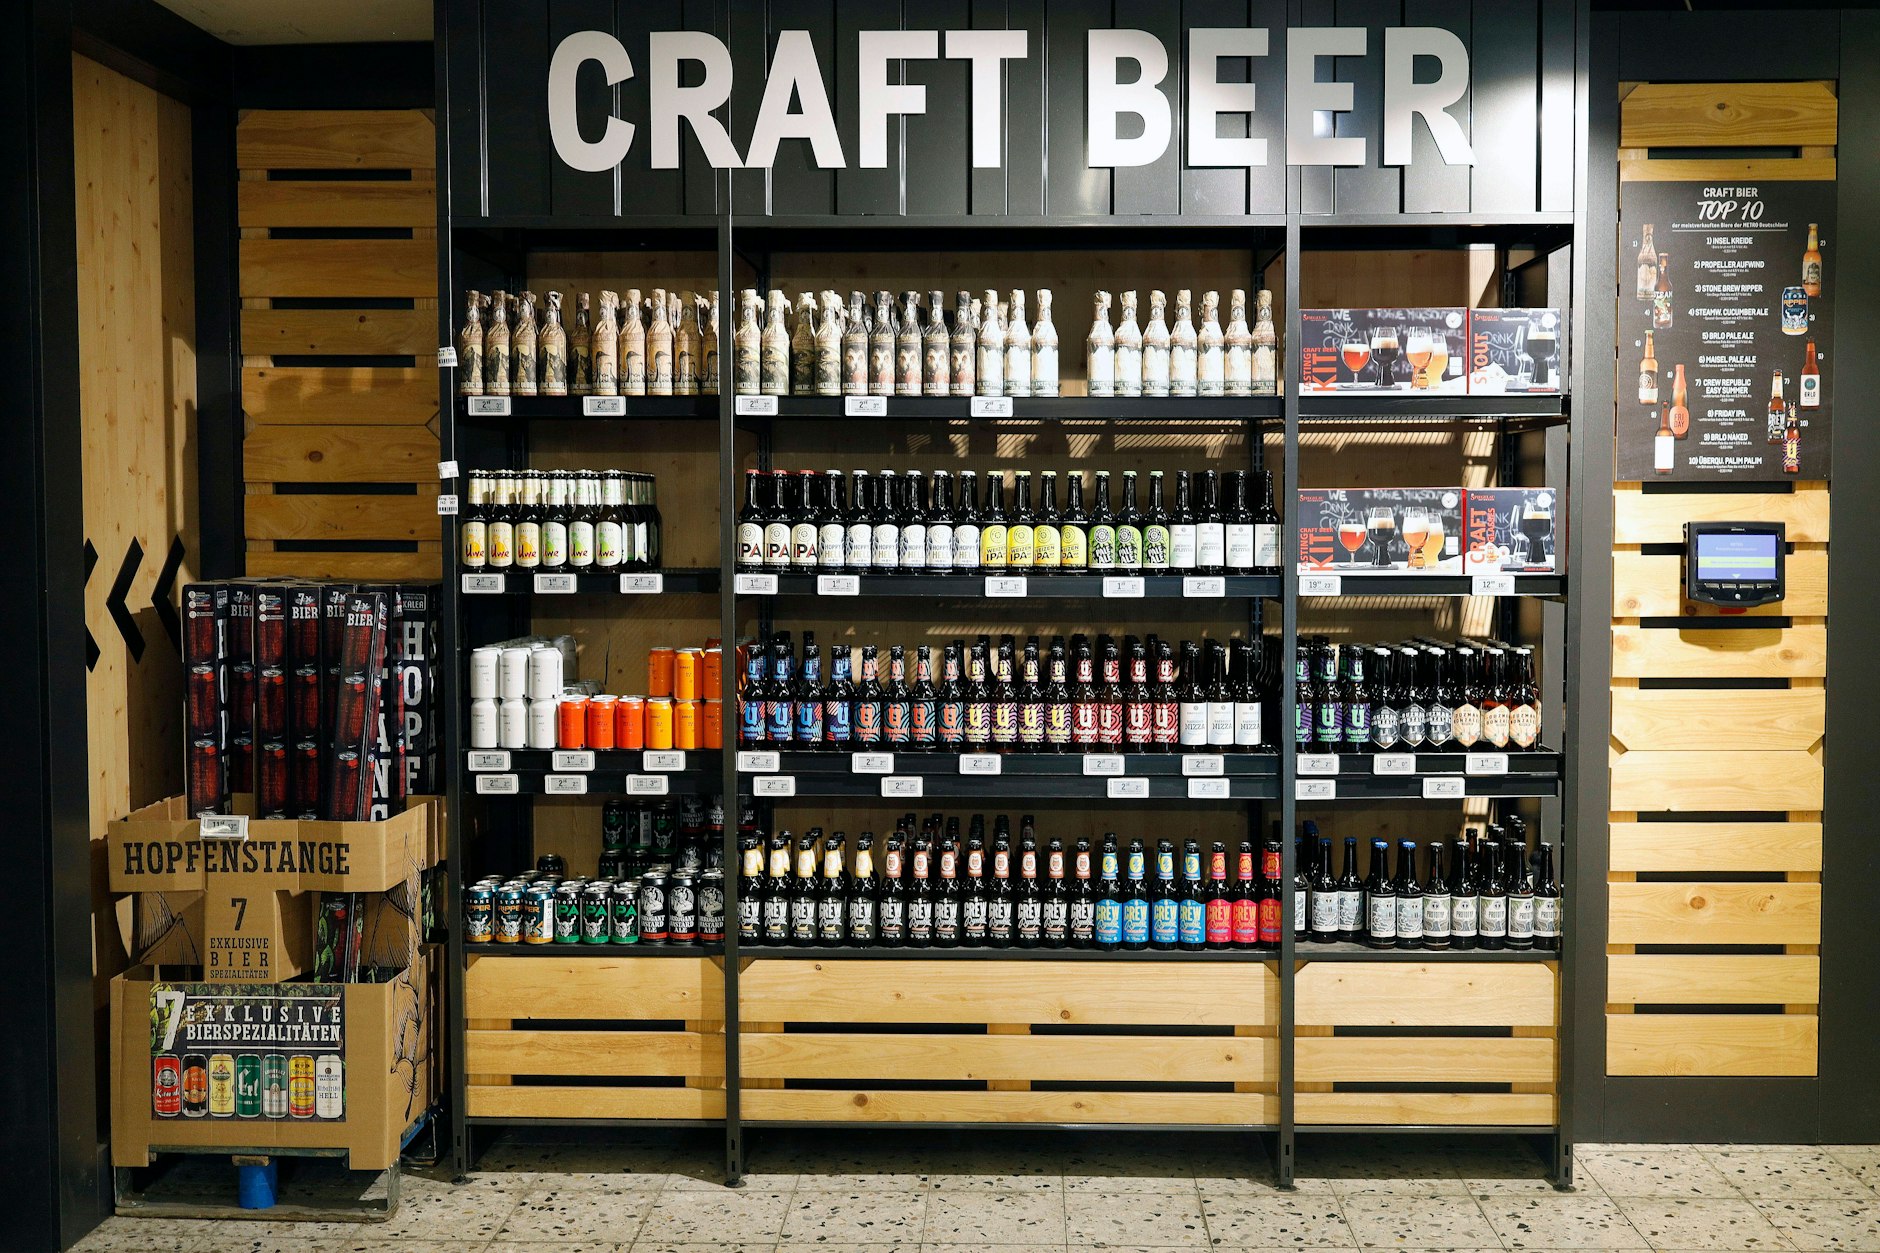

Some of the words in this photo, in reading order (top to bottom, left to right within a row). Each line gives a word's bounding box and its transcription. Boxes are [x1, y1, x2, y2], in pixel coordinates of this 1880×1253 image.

[548, 29, 1028, 172] CRAFT
[1088, 27, 1479, 168] BEER
[1704, 188, 1734, 197] CRAFT
[1736, 188, 1758, 197] BIER
[1697, 200, 1737, 220] TOP
[1741, 201, 1764, 220] 10
[1332, 310, 1351, 320] WE
[1474, 333, 1488, 384] STOUT
[1303, 353, 1311, 392] TASTING
[1312, 354, 1336, 391] KIT
[1328, 490, 1347, 501] WE
[1470, 508, 1486, 563] CRAFT
[738, 543, 762, 558] IPA
[766, 543, 791, 558] IPA
[793, 543, 818, 558] IPA
[986, 552, 1003, 561] IPA
[1010, 551, 1027, 562] IPA
[1309, 534, 1334, 570] KIT
[292, 606, 318, 619] BIER
[327, 605, 345, 618] BIE
[347, 614, 374, 626] BIER
[123, 840, 350, 875] HOPFENSTANGE
[231, 898, 248, 931] 7
[764, 902, 787, 917] CREW
[819, 903, 842, 918] CREW
[880, 902, 902, 919] CREW
[908, 903, 932, 919] CREW
[964, 902, 987, 918] CREW
[1018, 903, 1041, 919] CREW
[1071, 903, 1094, 919] CREW
[1097, 905, 1120, 920] CREW
[1154, 905, 1177, 920] CREW
[1207, 906, 1230, 920] CREW
[210, 937, 269, 949] EXKLUSIVE
[210, 952, 269, 967] BIER
[210, 969, 269, 979] SPEZIALITÄTEN
[157, 990, 185, 1050] 7
[187, 1005, 341, 1022] EXKLUSIVE
[186, 1022, 341, 1042] BIERSPEZIALITÄTEN
